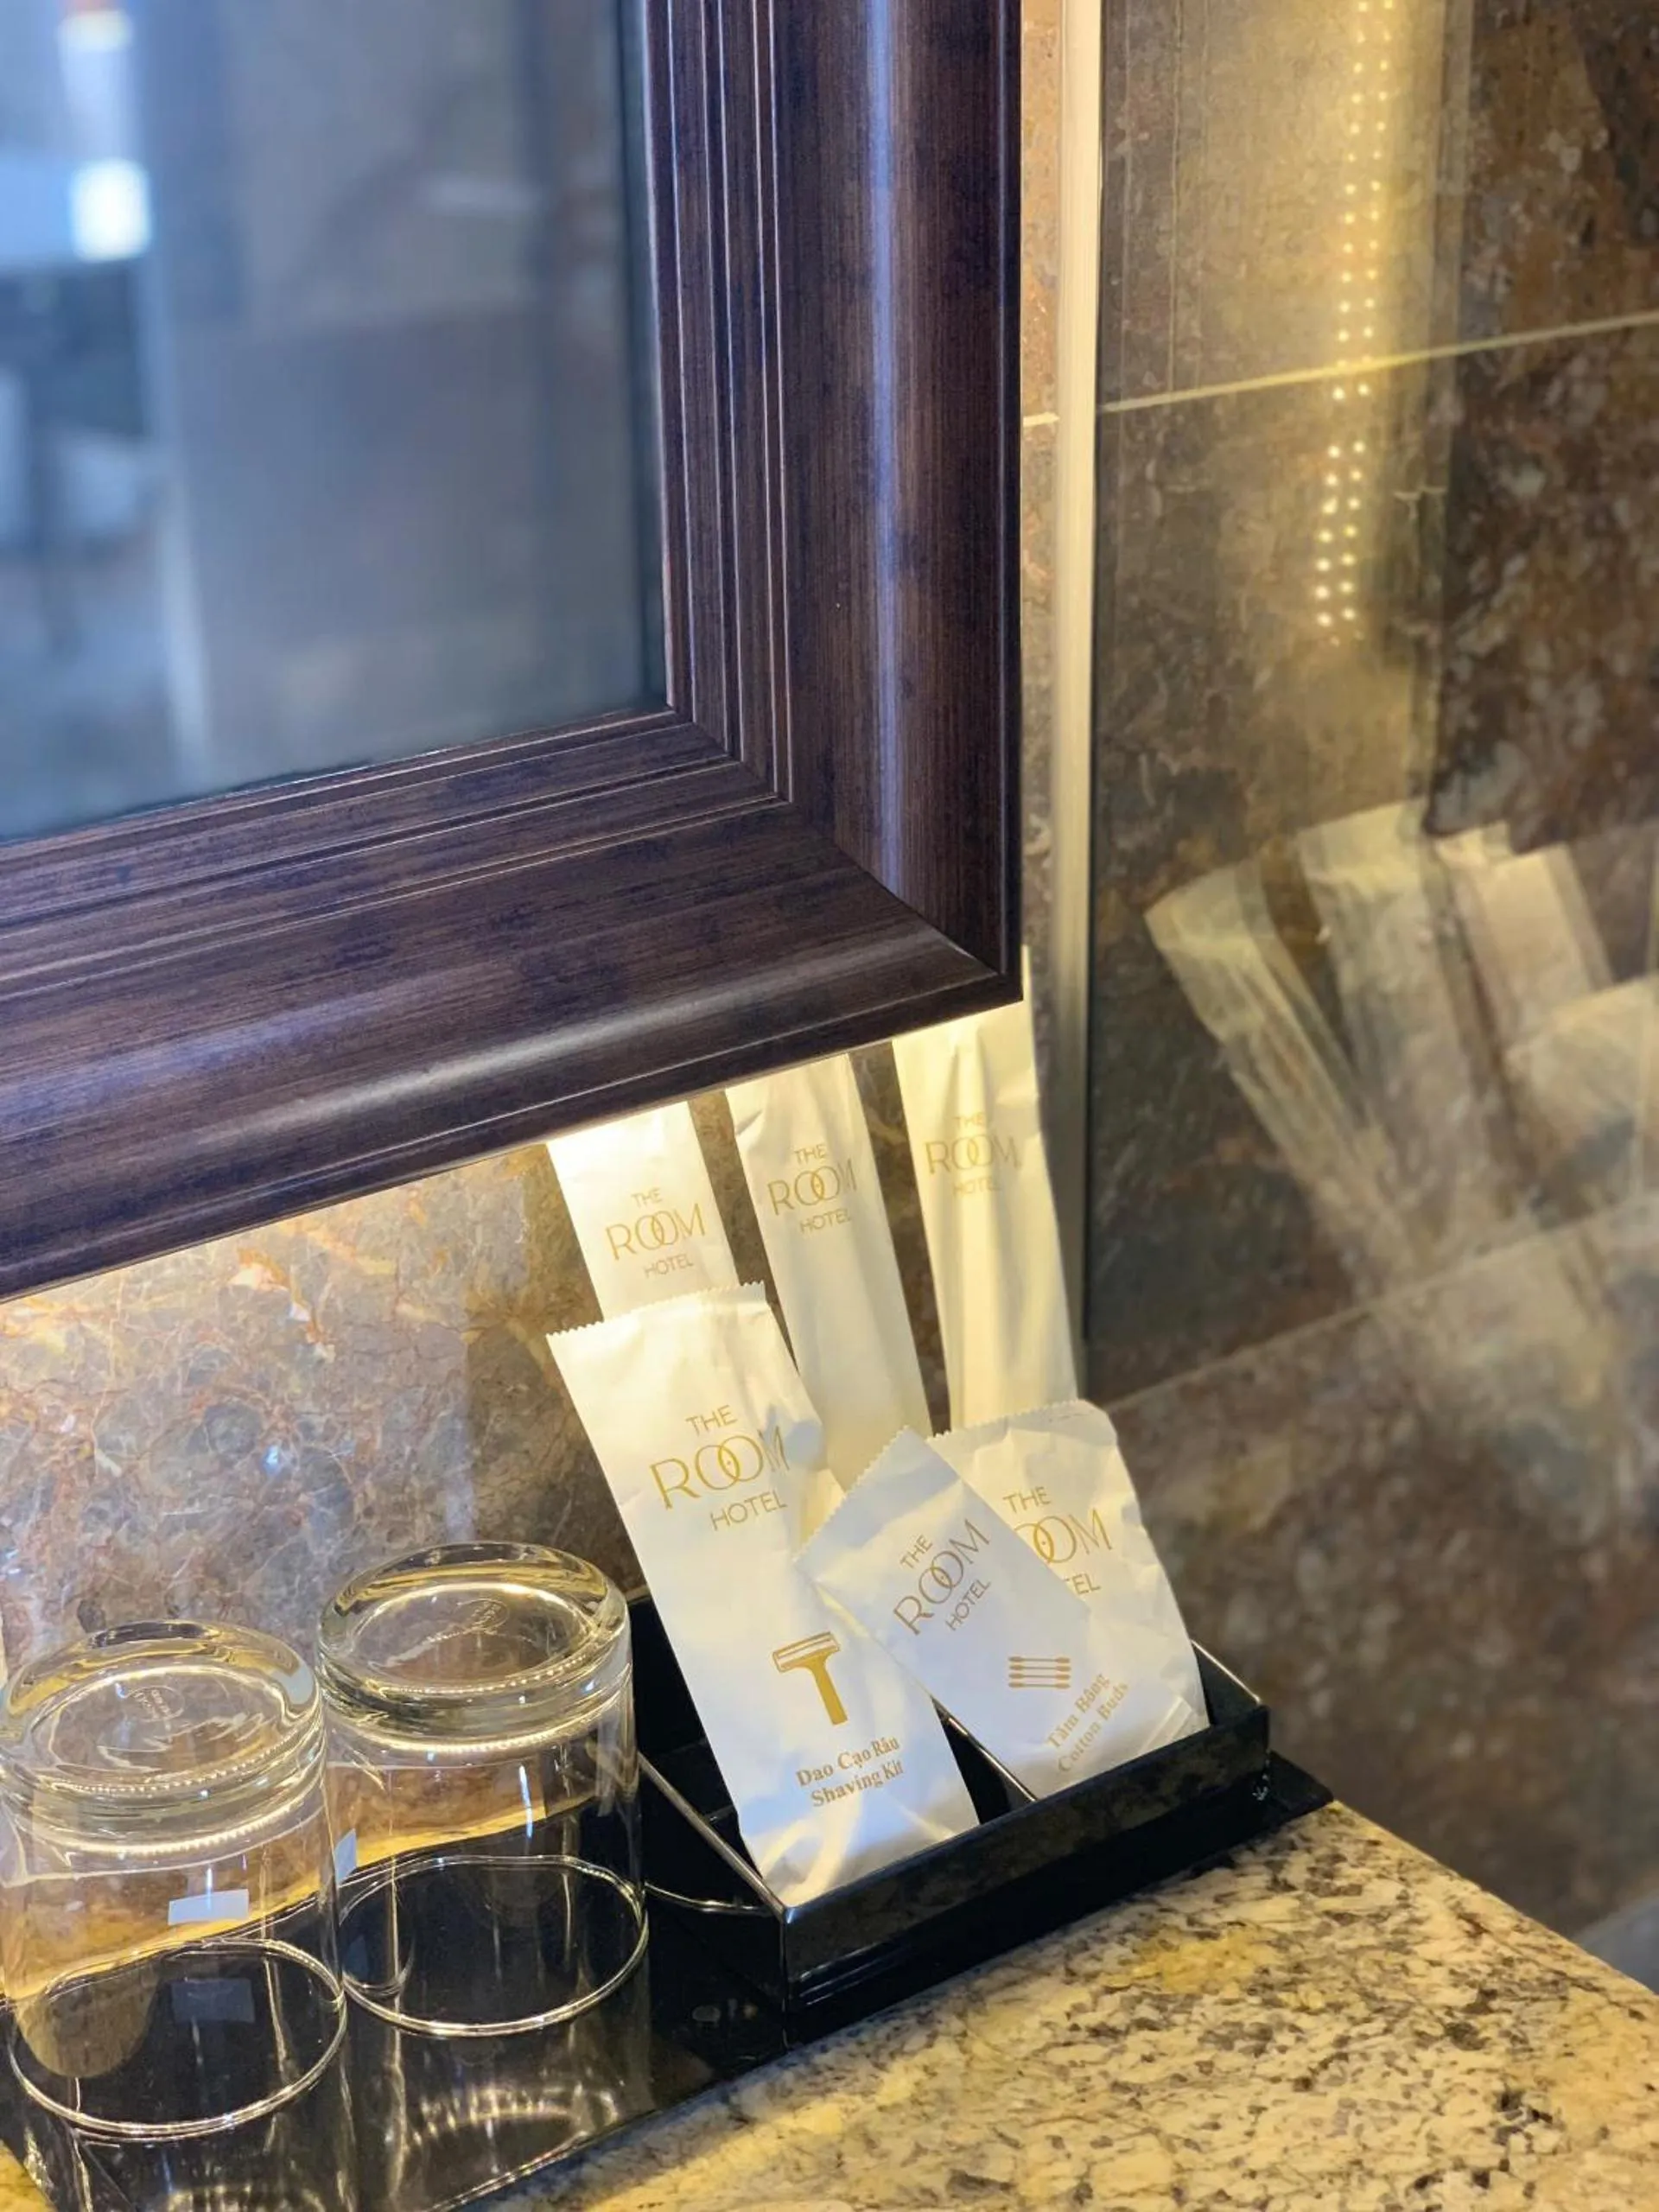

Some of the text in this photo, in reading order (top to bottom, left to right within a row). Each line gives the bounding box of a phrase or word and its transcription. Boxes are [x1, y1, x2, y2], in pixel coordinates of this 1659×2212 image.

[793, 1143, 827, 1165] THE
[925, 1131, 1023, 1175] ROOM
[630, 1187, 664, 1209] THE
[767, 1157, 858, 1217] ROOM
[952, 1176, 1001, 1198] HOTEL
[605, 1203, 706, 1262] ROOM
[799, 1208, 852, 1234] HOTEL
[643, 1254, 695, 1279] HOTEL
[685, 1405, 738, 1436] THE
[649, 1426, 790, 1510] ROOM
[709, 1490, 788, 1531] HOTEL
[1001, 1486, 1052, 1514] THE
[899, 1535, 933, 1570] THE
[1013, 1508, 1113, 1564] OOM
[893, 1518, 990, 1636] ROOM
[944, 1579, 992, 1631] HOTEL
[1058, 1681, 1129, 1772] Cotton Buds
[796, 1764, 835, 1787] Dao
[837, 1750, 873, 1770] Cạo
[810, 1758, 904, 1808] Shaving Kit
